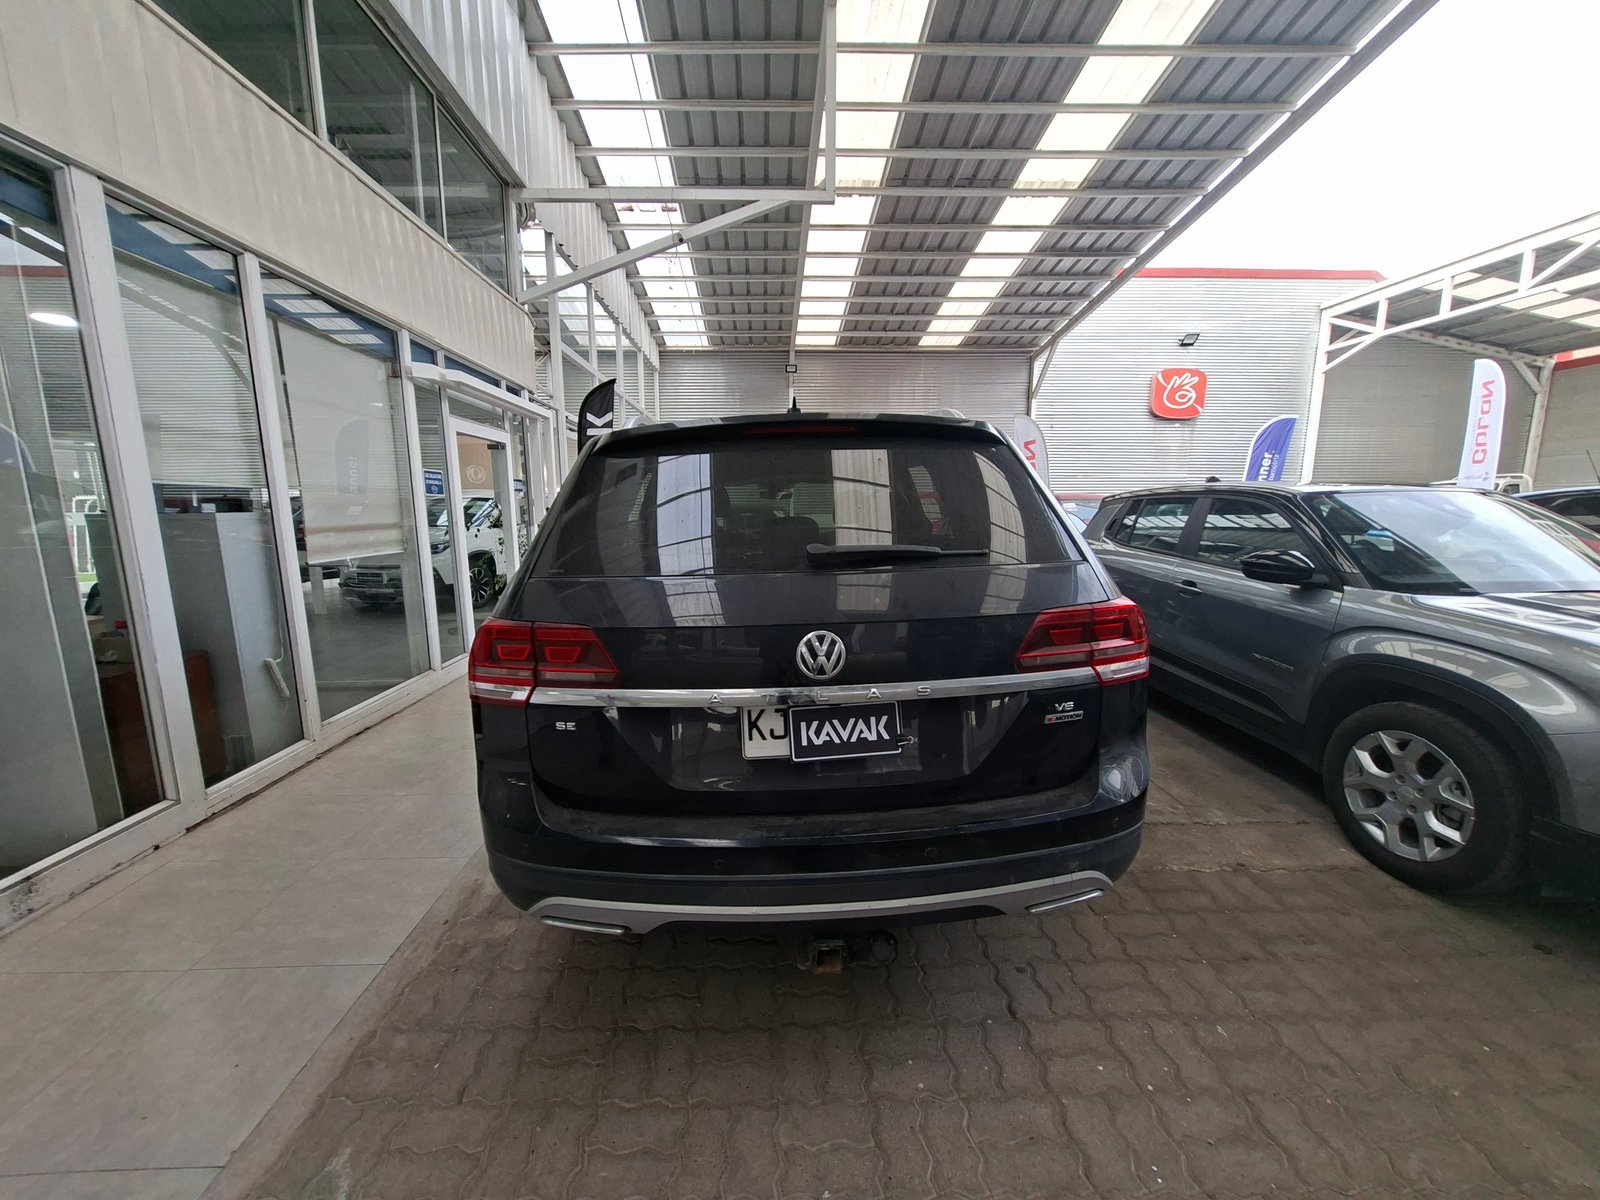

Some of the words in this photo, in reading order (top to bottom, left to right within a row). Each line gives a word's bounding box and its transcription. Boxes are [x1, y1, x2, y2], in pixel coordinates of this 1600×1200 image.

[707, 685, 932, 705] ATLAS
[555, 721, 577, 730] SE
[800, 715, 890, 747] KAVAK
